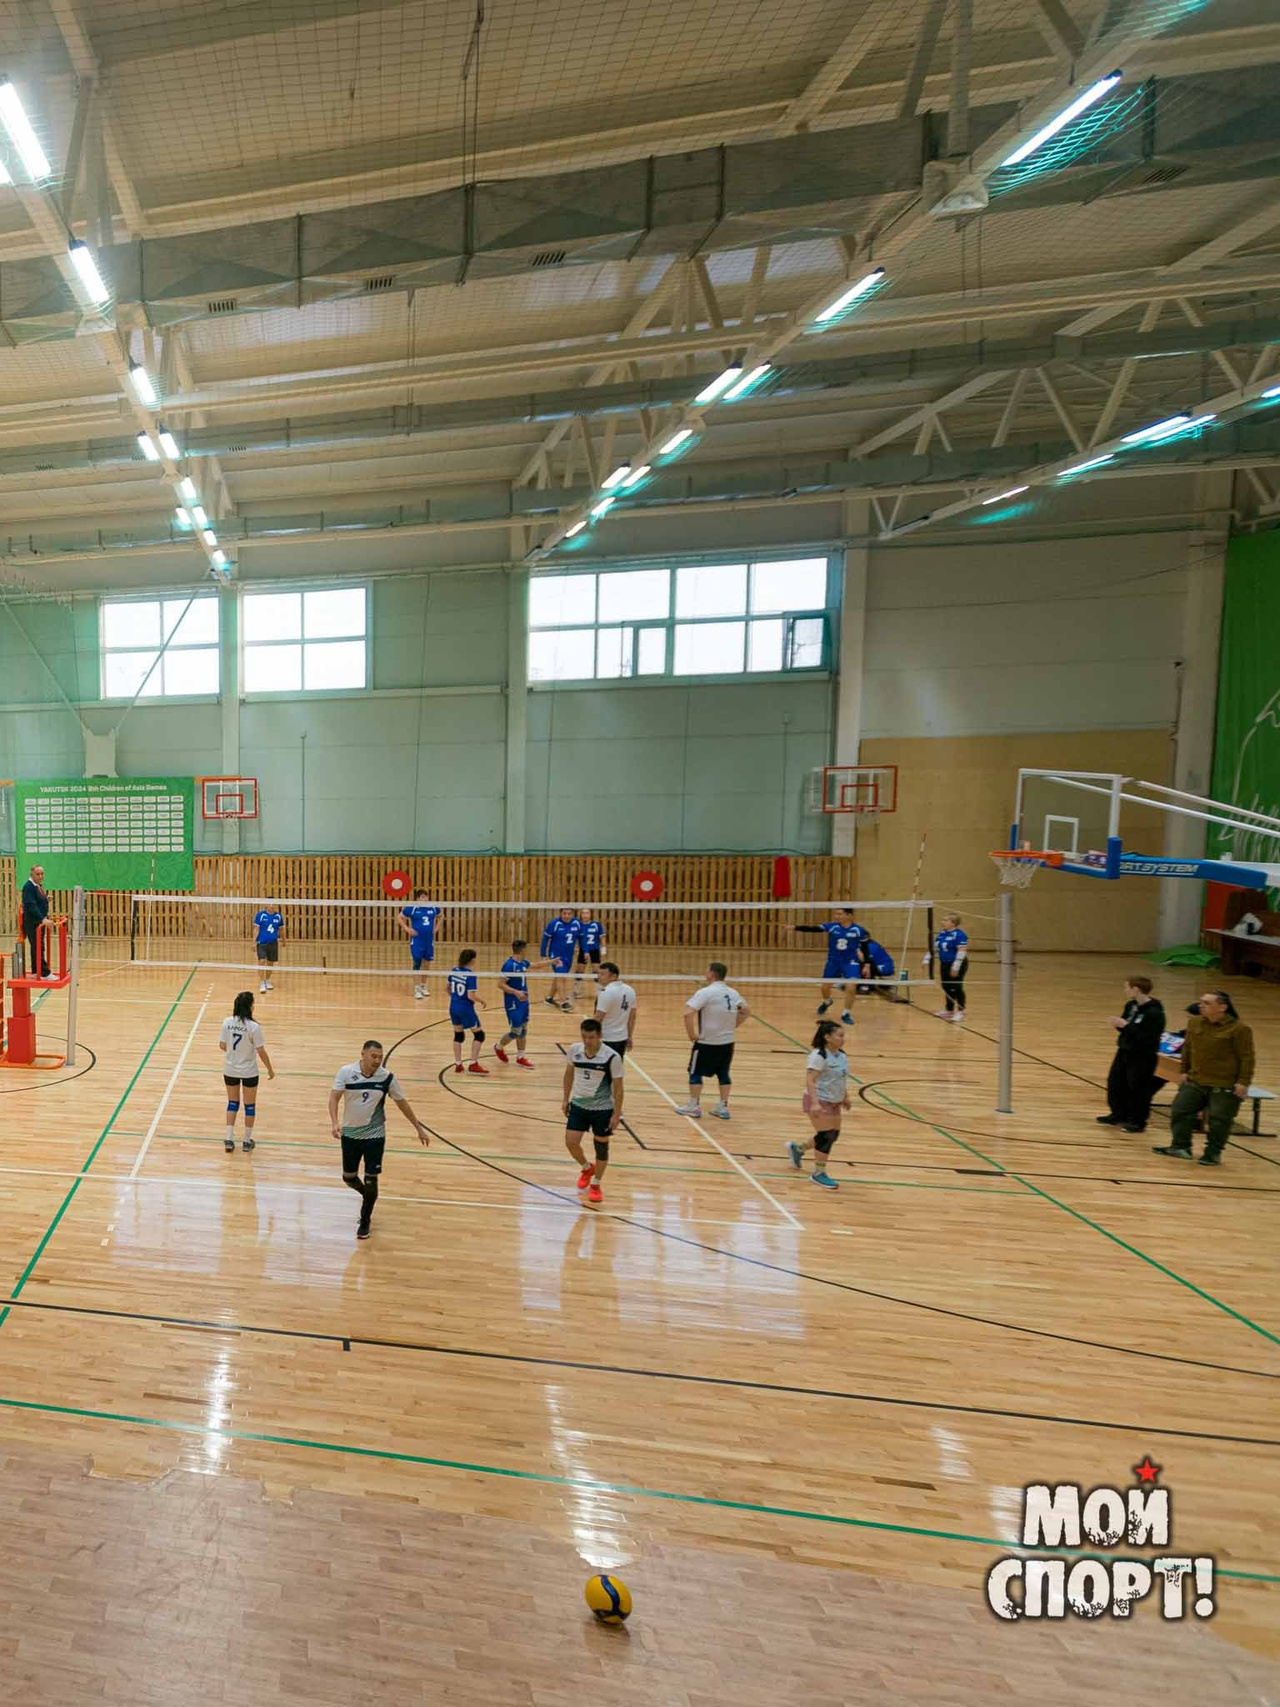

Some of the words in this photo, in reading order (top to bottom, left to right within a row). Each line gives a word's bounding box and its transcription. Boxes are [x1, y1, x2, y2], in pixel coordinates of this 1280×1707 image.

[422, 917, 430, 926] 3
[836, 938, 848, 950] 8
[451, 981, 466, 996] 10
[233, 1033, 242, 1051] 7
[362, 1091, 369, 1102] 9
